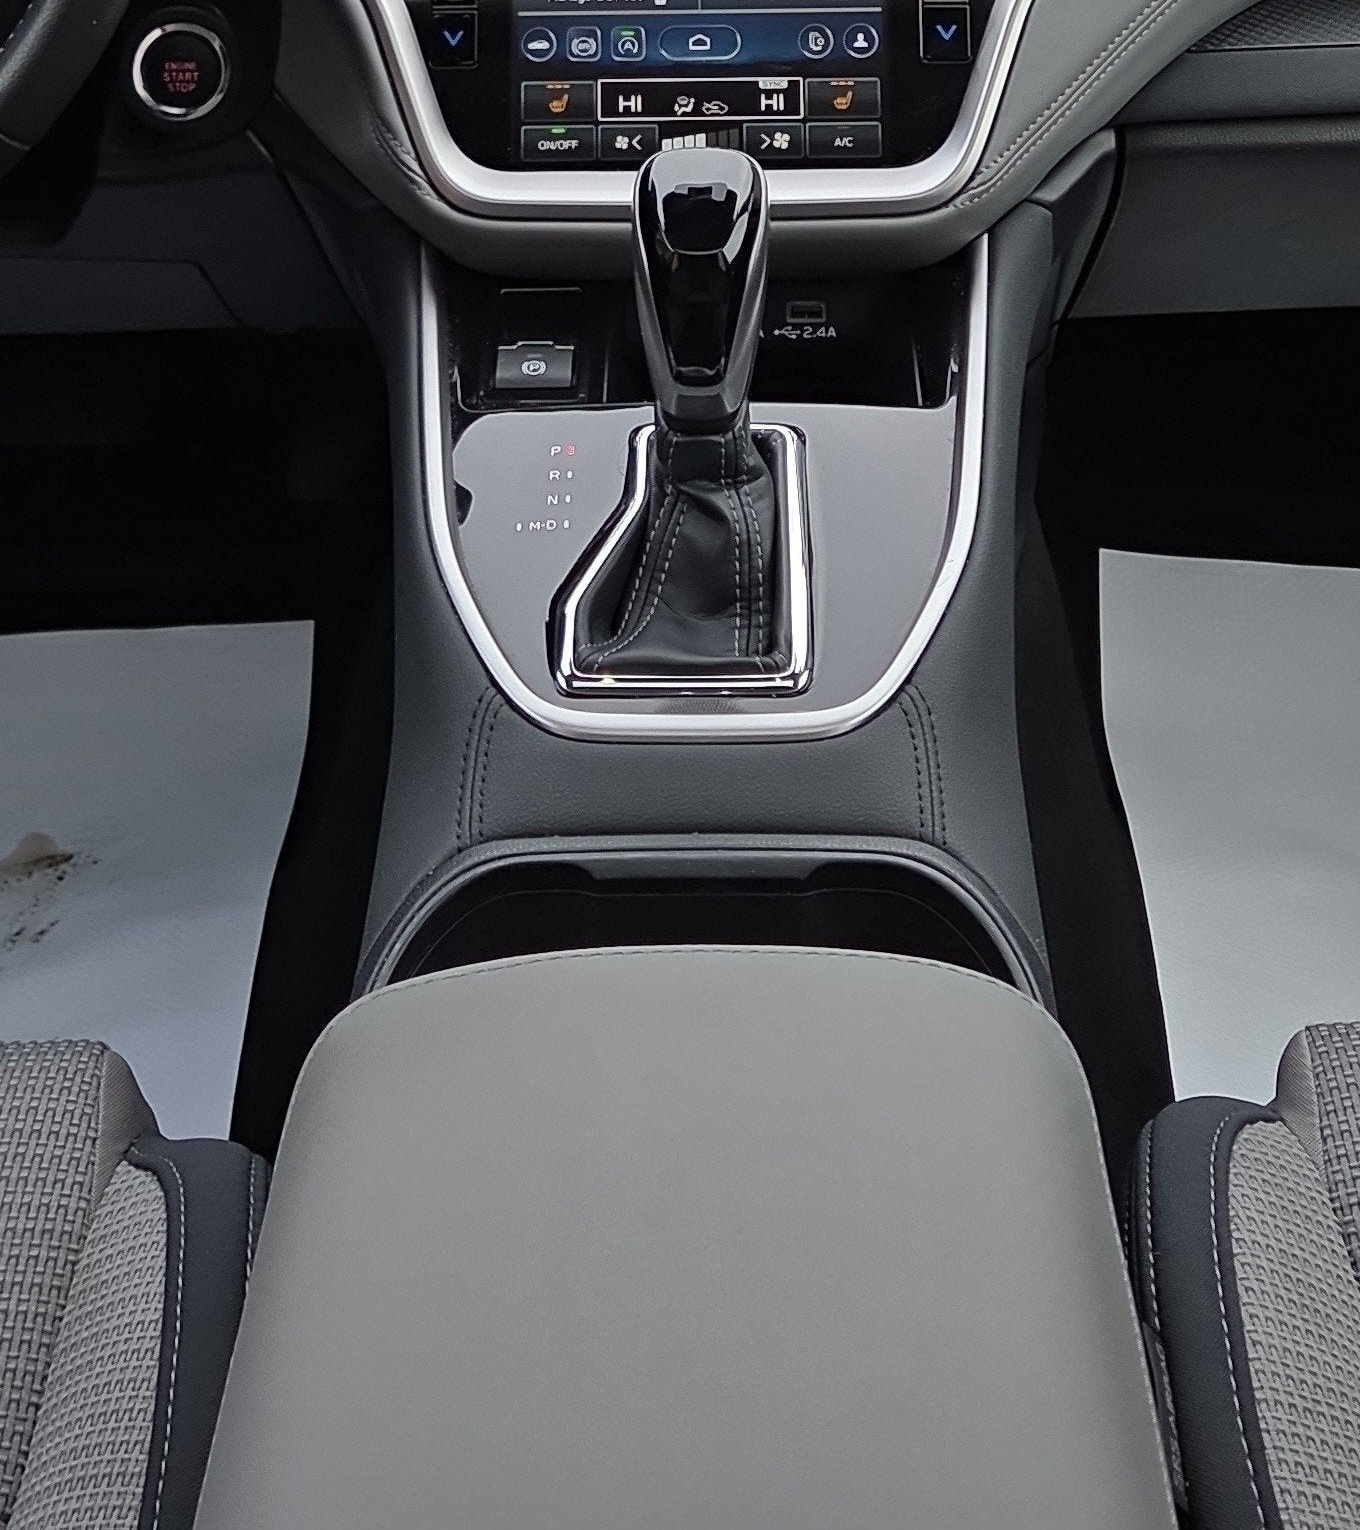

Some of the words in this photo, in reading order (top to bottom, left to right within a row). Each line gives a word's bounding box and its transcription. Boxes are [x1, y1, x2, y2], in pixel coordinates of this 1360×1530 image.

[165, 62, 196, 70] ENGINE
[163, 72, 200, 82] START
[167, 83, 196, 92] STOP
[618, 94, 642, 114] HI
[760, 92, 784, 112] HI
[538, 139, 579, 151] ON/OFF
[833, 137, 854, 148] A/C
[802, 326, 837, 338] 2.4A
[550, 445, 562, 456] P
[549, 470, 560, 481] R
[547, 494, 559, 506] N
